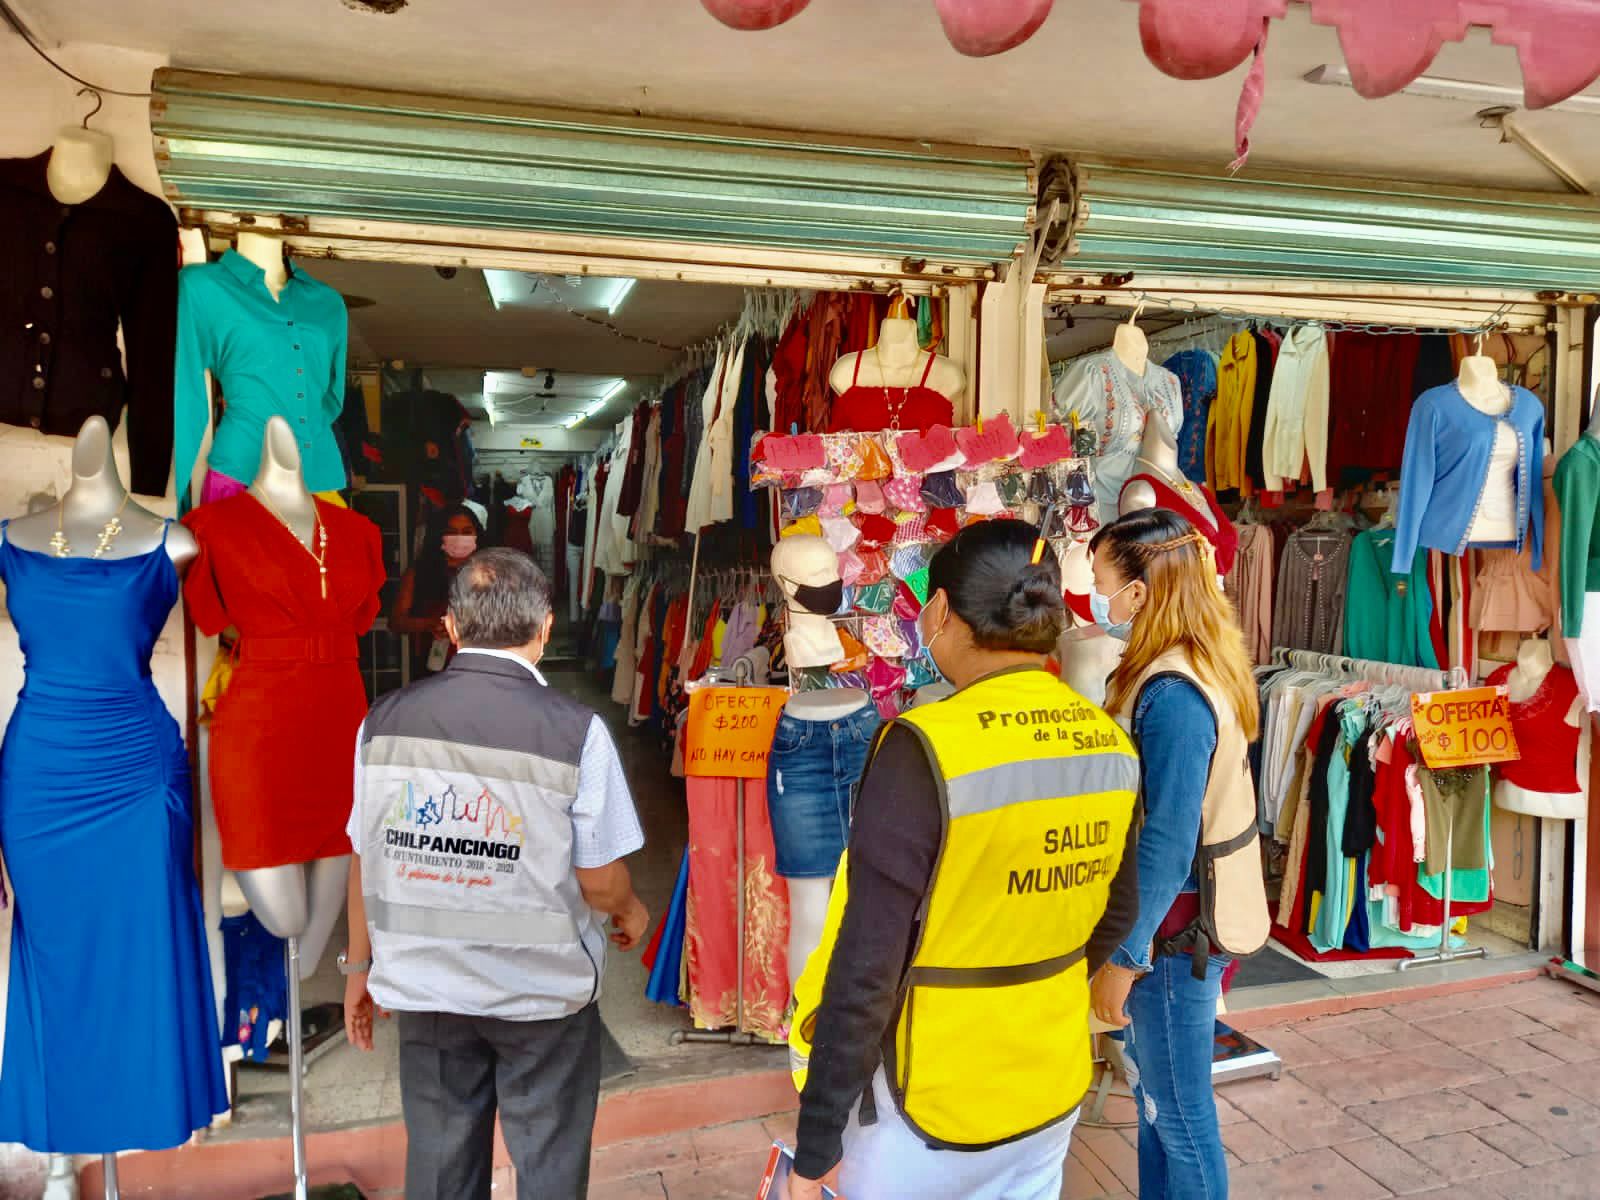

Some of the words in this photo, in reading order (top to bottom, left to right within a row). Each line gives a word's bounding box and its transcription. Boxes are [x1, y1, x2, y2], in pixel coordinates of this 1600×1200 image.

[703, 694, 771, 711] OFERTA
[1426, 699, 1504, 726] OFERTA
[712, 714, 758, 730] $200
[976, 701, 1096, 730] Promoción
[1034, 729, 1050, 742] de
[1057, 727, 1068, 740] la
[1072, 729, 1119, 750] Salud
[691, 748, 706, 762] NO
[714, 746, 736, 763] HAY
[740, 751, 769, 762] CAM
[385, 828, 521, 861] CHILPANCINGO
[1044, 820, 1110, 855] SALUD
